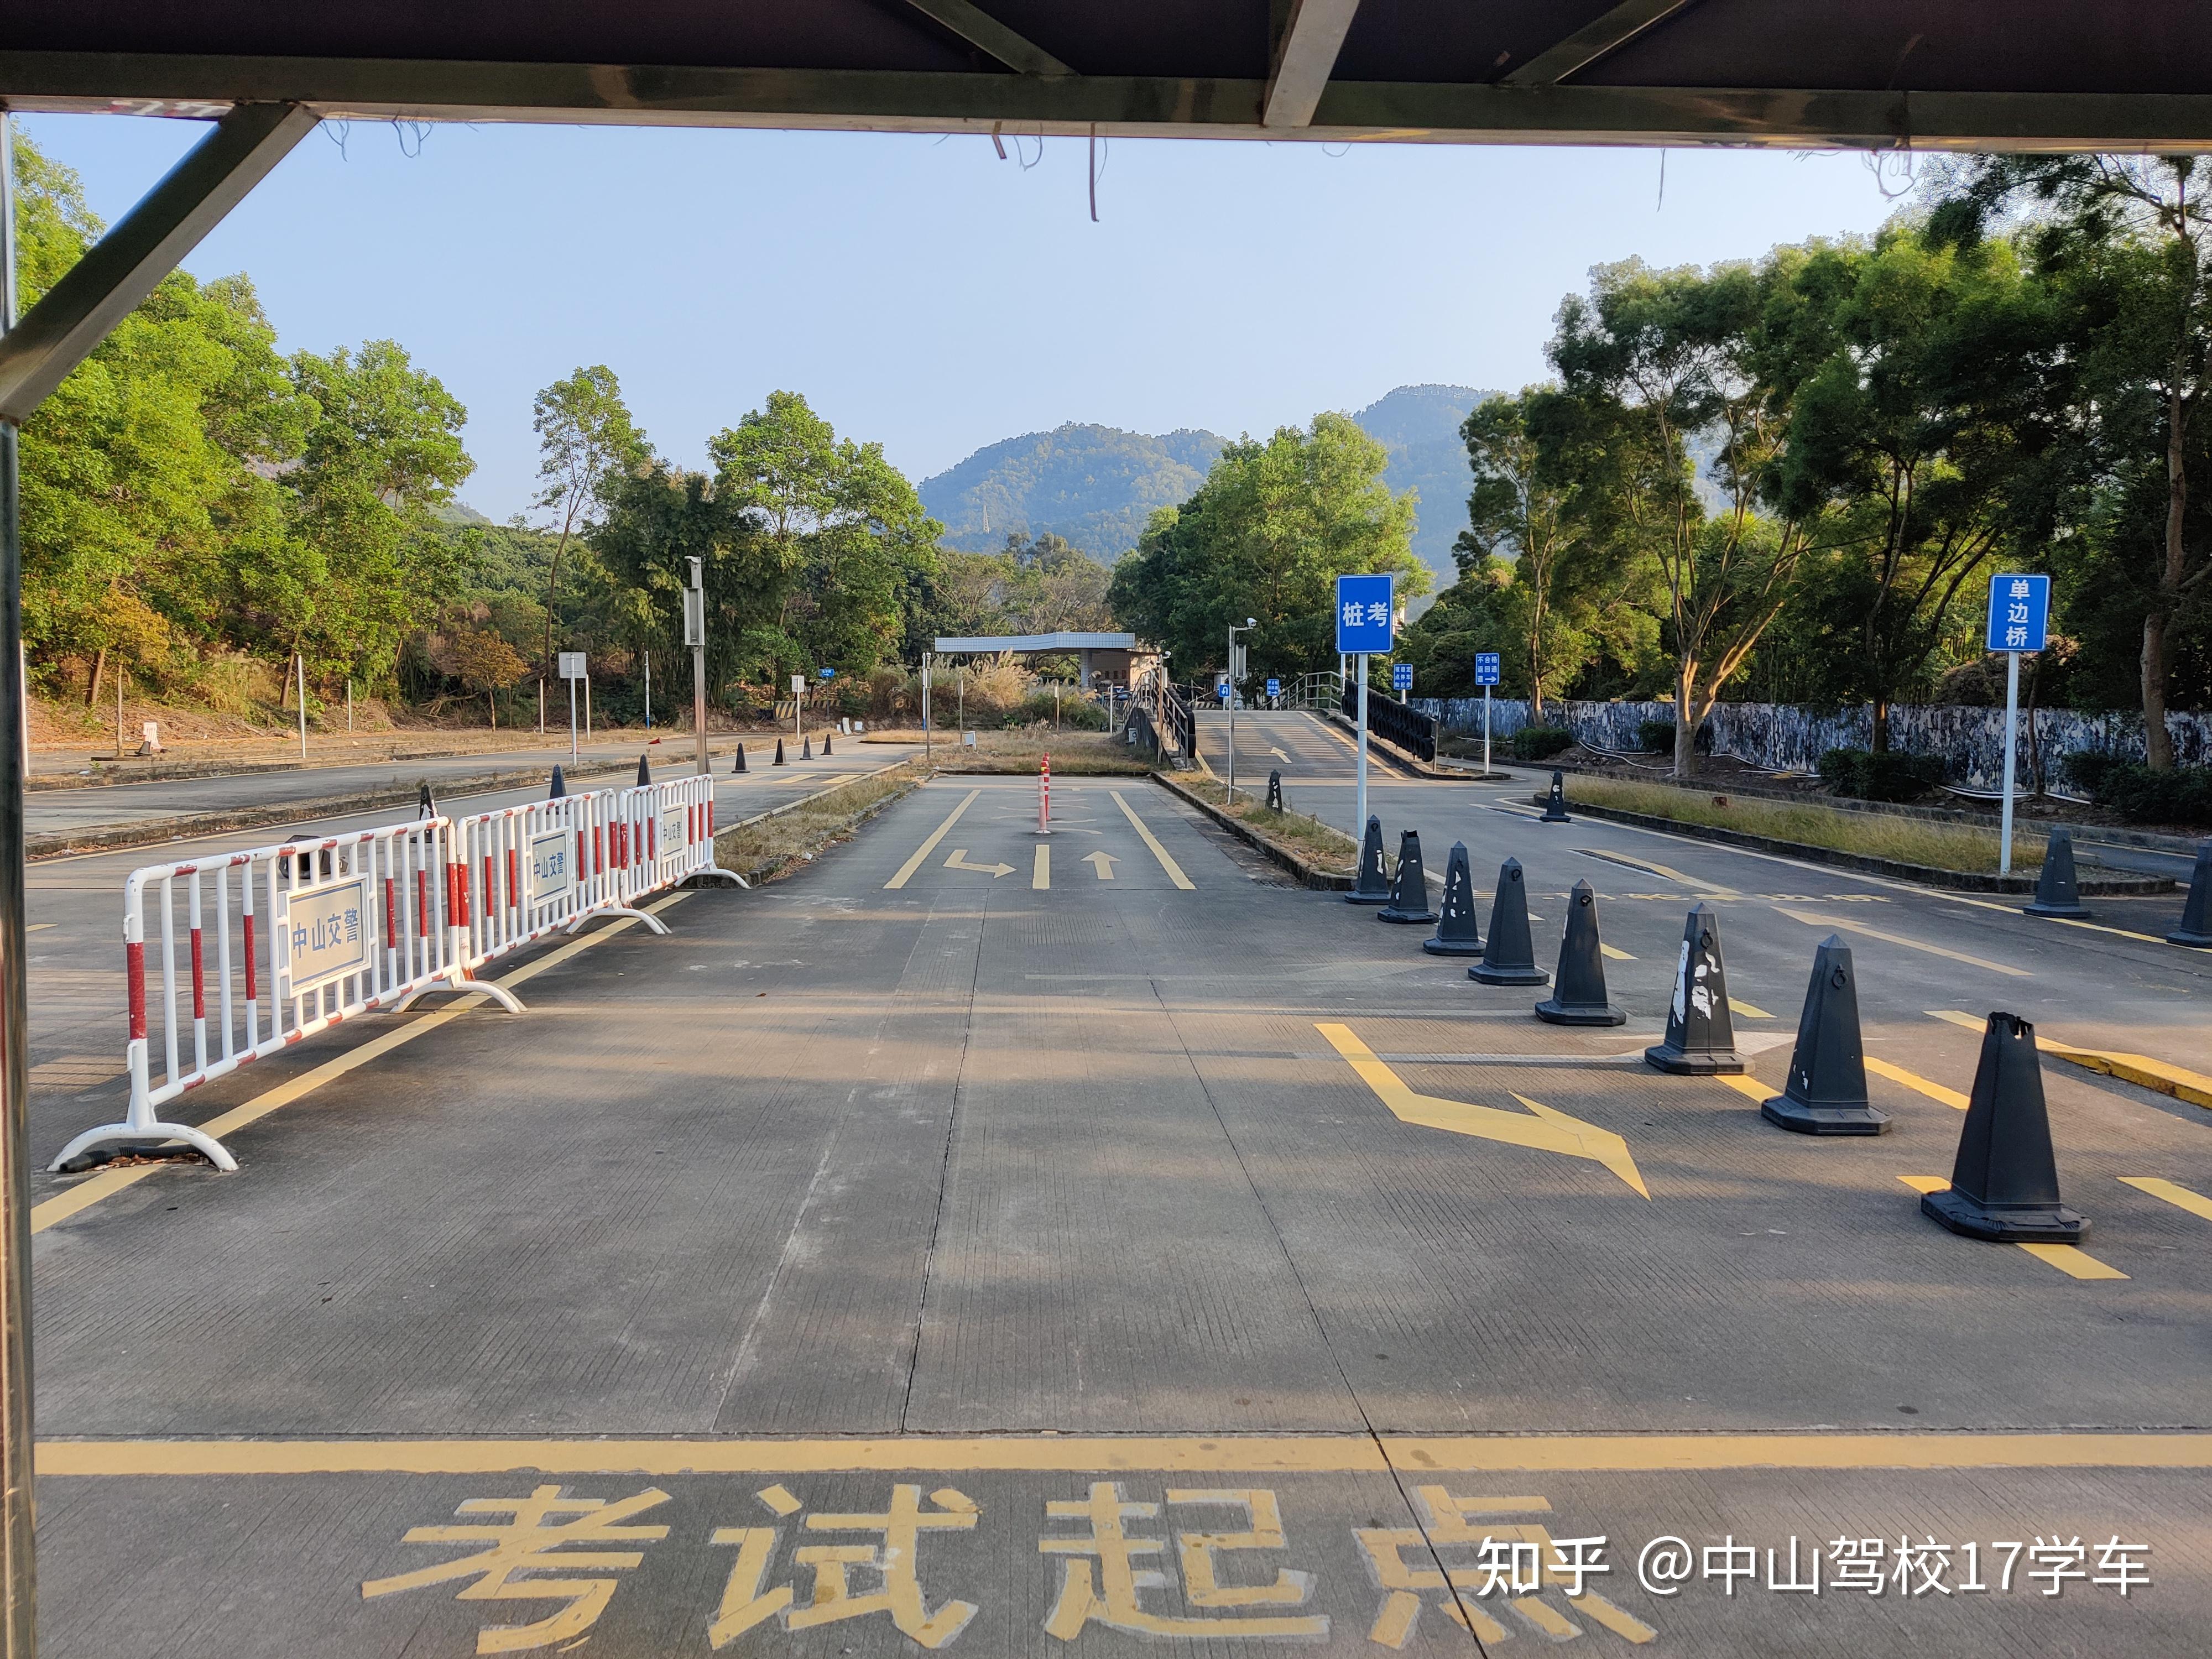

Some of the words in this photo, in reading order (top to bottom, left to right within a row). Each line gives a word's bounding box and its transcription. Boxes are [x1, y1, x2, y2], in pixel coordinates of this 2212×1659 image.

[1343, 601, 1389, 627] 桩考
[2006, 579, 2030, 646] 单边桥
[534, 851, 564, 883] 中山交警
[293, 907, 358, 958] 中山交警
[361, 1481, 1656, 1654] 考试起点
